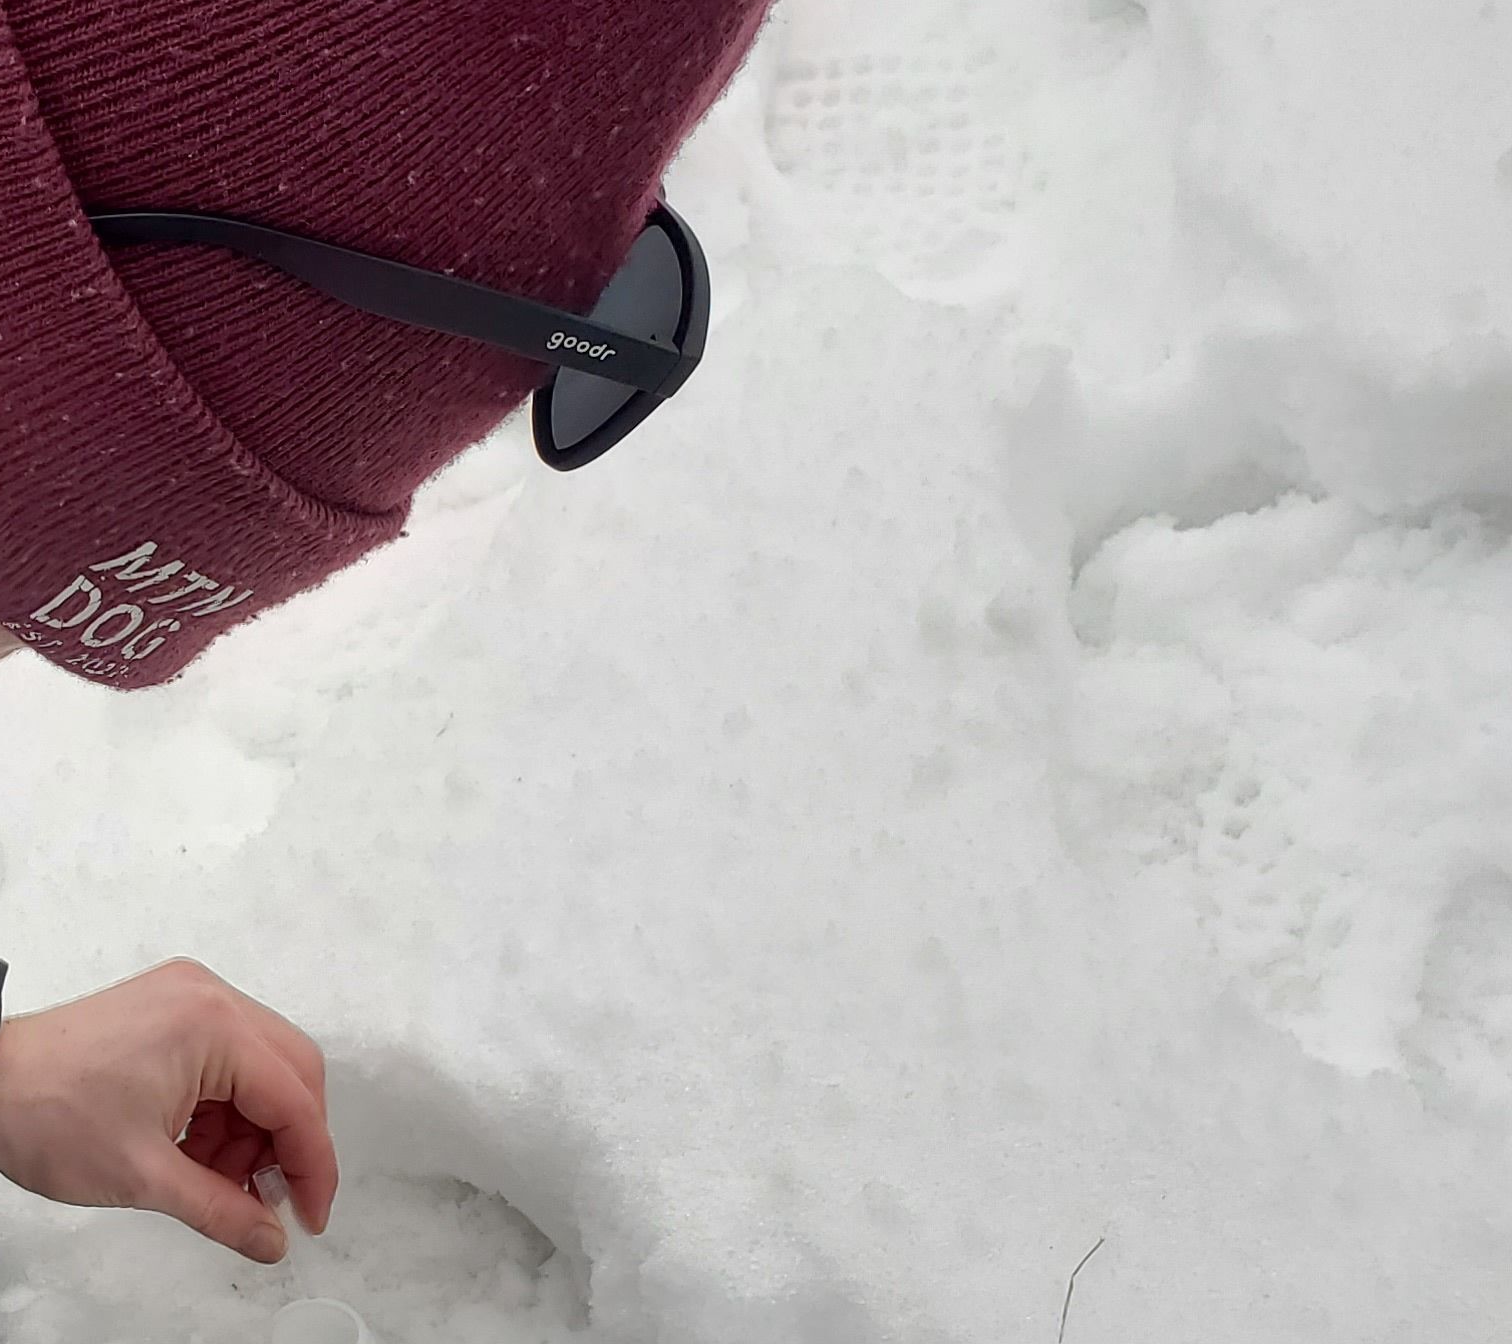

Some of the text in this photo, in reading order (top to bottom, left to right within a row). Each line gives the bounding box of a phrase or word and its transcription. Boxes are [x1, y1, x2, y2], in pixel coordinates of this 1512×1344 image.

[546, 332, 616, 361] goodr
[29, 574, 181, 660] DOG
[89, 541, 254, 617] MTN
